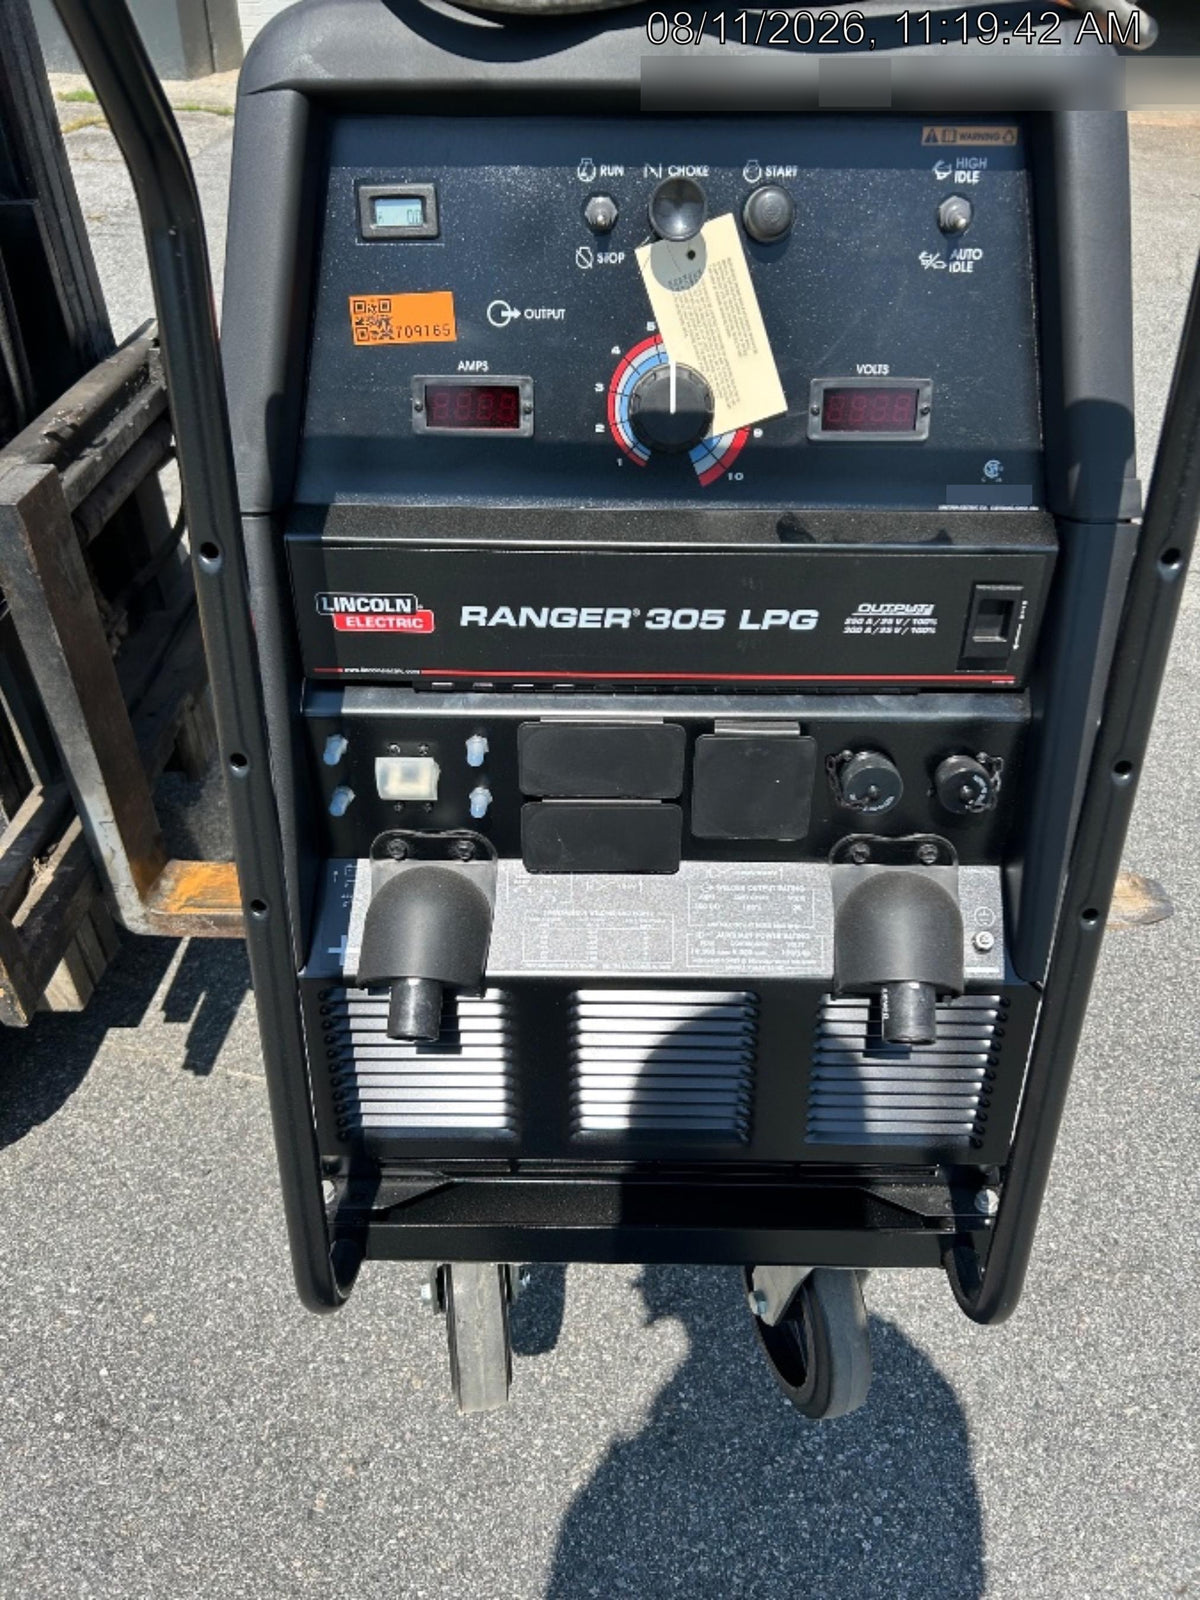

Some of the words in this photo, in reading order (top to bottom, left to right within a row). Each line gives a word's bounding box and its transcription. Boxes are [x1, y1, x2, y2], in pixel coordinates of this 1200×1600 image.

[956, 157, 988, 169] HIGH
[600, 165, 625, 177] RUN
[668, 165, 710, 177] CHOKE
[765, 165, 798, 177] START
[954, 170, 981, 183] IDLE
[597, 252, 625, 264] STOP
[950, 248, 983, 260] AUTO
[949, 261, 974, 273] IDLE
[524, 308, 566, 321] OUTPUT
[396, 323, 451, 339] 709165
[646, 321, 656, 331] 5
[611, 345, 621, 355] 4
[457, 360, 489, 372] AMPS
[856, 363, 890, 375] VOLTS
[594, 383, 605, 392] 3
[595, 424, 605, 433] 2
[617, 458, 623, 467] 1
[728, 472, 744, 481] 10
[321, 597, 412, 613] LINCOLN
[857, 603, 932, 614] OUTPUT
[345, 616, 424, 628] ELECTRIC
[645, 608, 726, 631] 305
[738, 609, 819, 631] LPG
